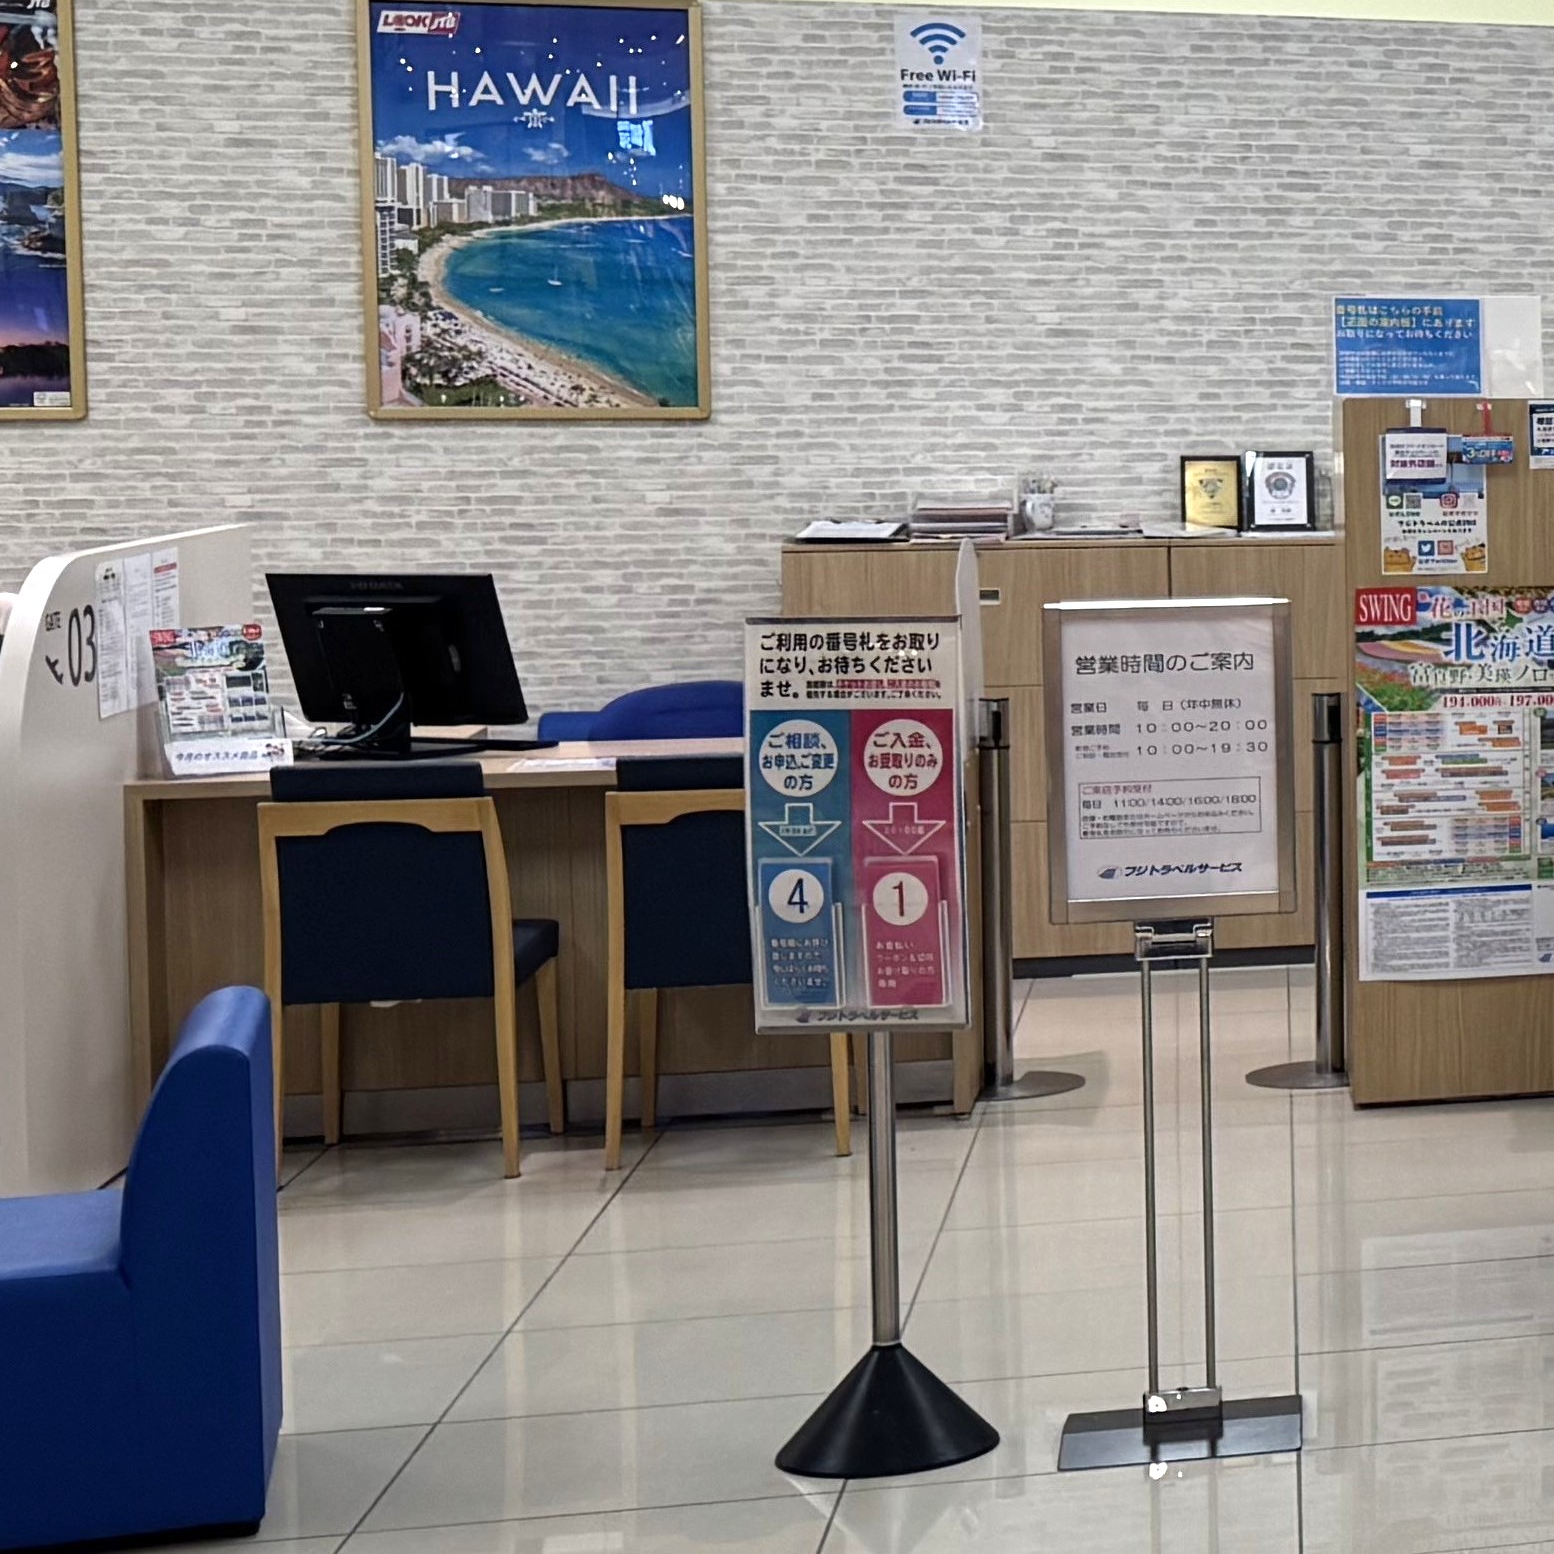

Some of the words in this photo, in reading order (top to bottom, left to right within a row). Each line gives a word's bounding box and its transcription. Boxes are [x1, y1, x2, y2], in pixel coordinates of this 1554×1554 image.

[900, 69, 934, 81] Free
[937, 70, 976, 82] Wi-Fi
[427, 71, 637, 115] HAWAII
[1359, 593, 1412, 623] SWING
[68, 604, 97, 688] 03
[760, 632, 941, 652] ご利用の番号札をお取り
[760, 655, 932, 676] になり、お待ちください
[1075, 652, 1255, 676] 営業時間のご案内
[760, 681, 799, 700] ませ。
[1070, 702, 1107, 715] 営業日
[1070, 723, 1121, 737] 営業時間
[873, 731, 932, 749] ご入金、
[868, 753, 938, 769] お受取りのみ
[783, 774, 814, 791] の方
[888, 773, 919, 790] の方
[1082, 799, 1102, 810] 毎日
[1124, 862, 1244, 878] フジトラベルサービス
[786, 877, 809, 915] 4
[891, 880, 905, 917] 1
